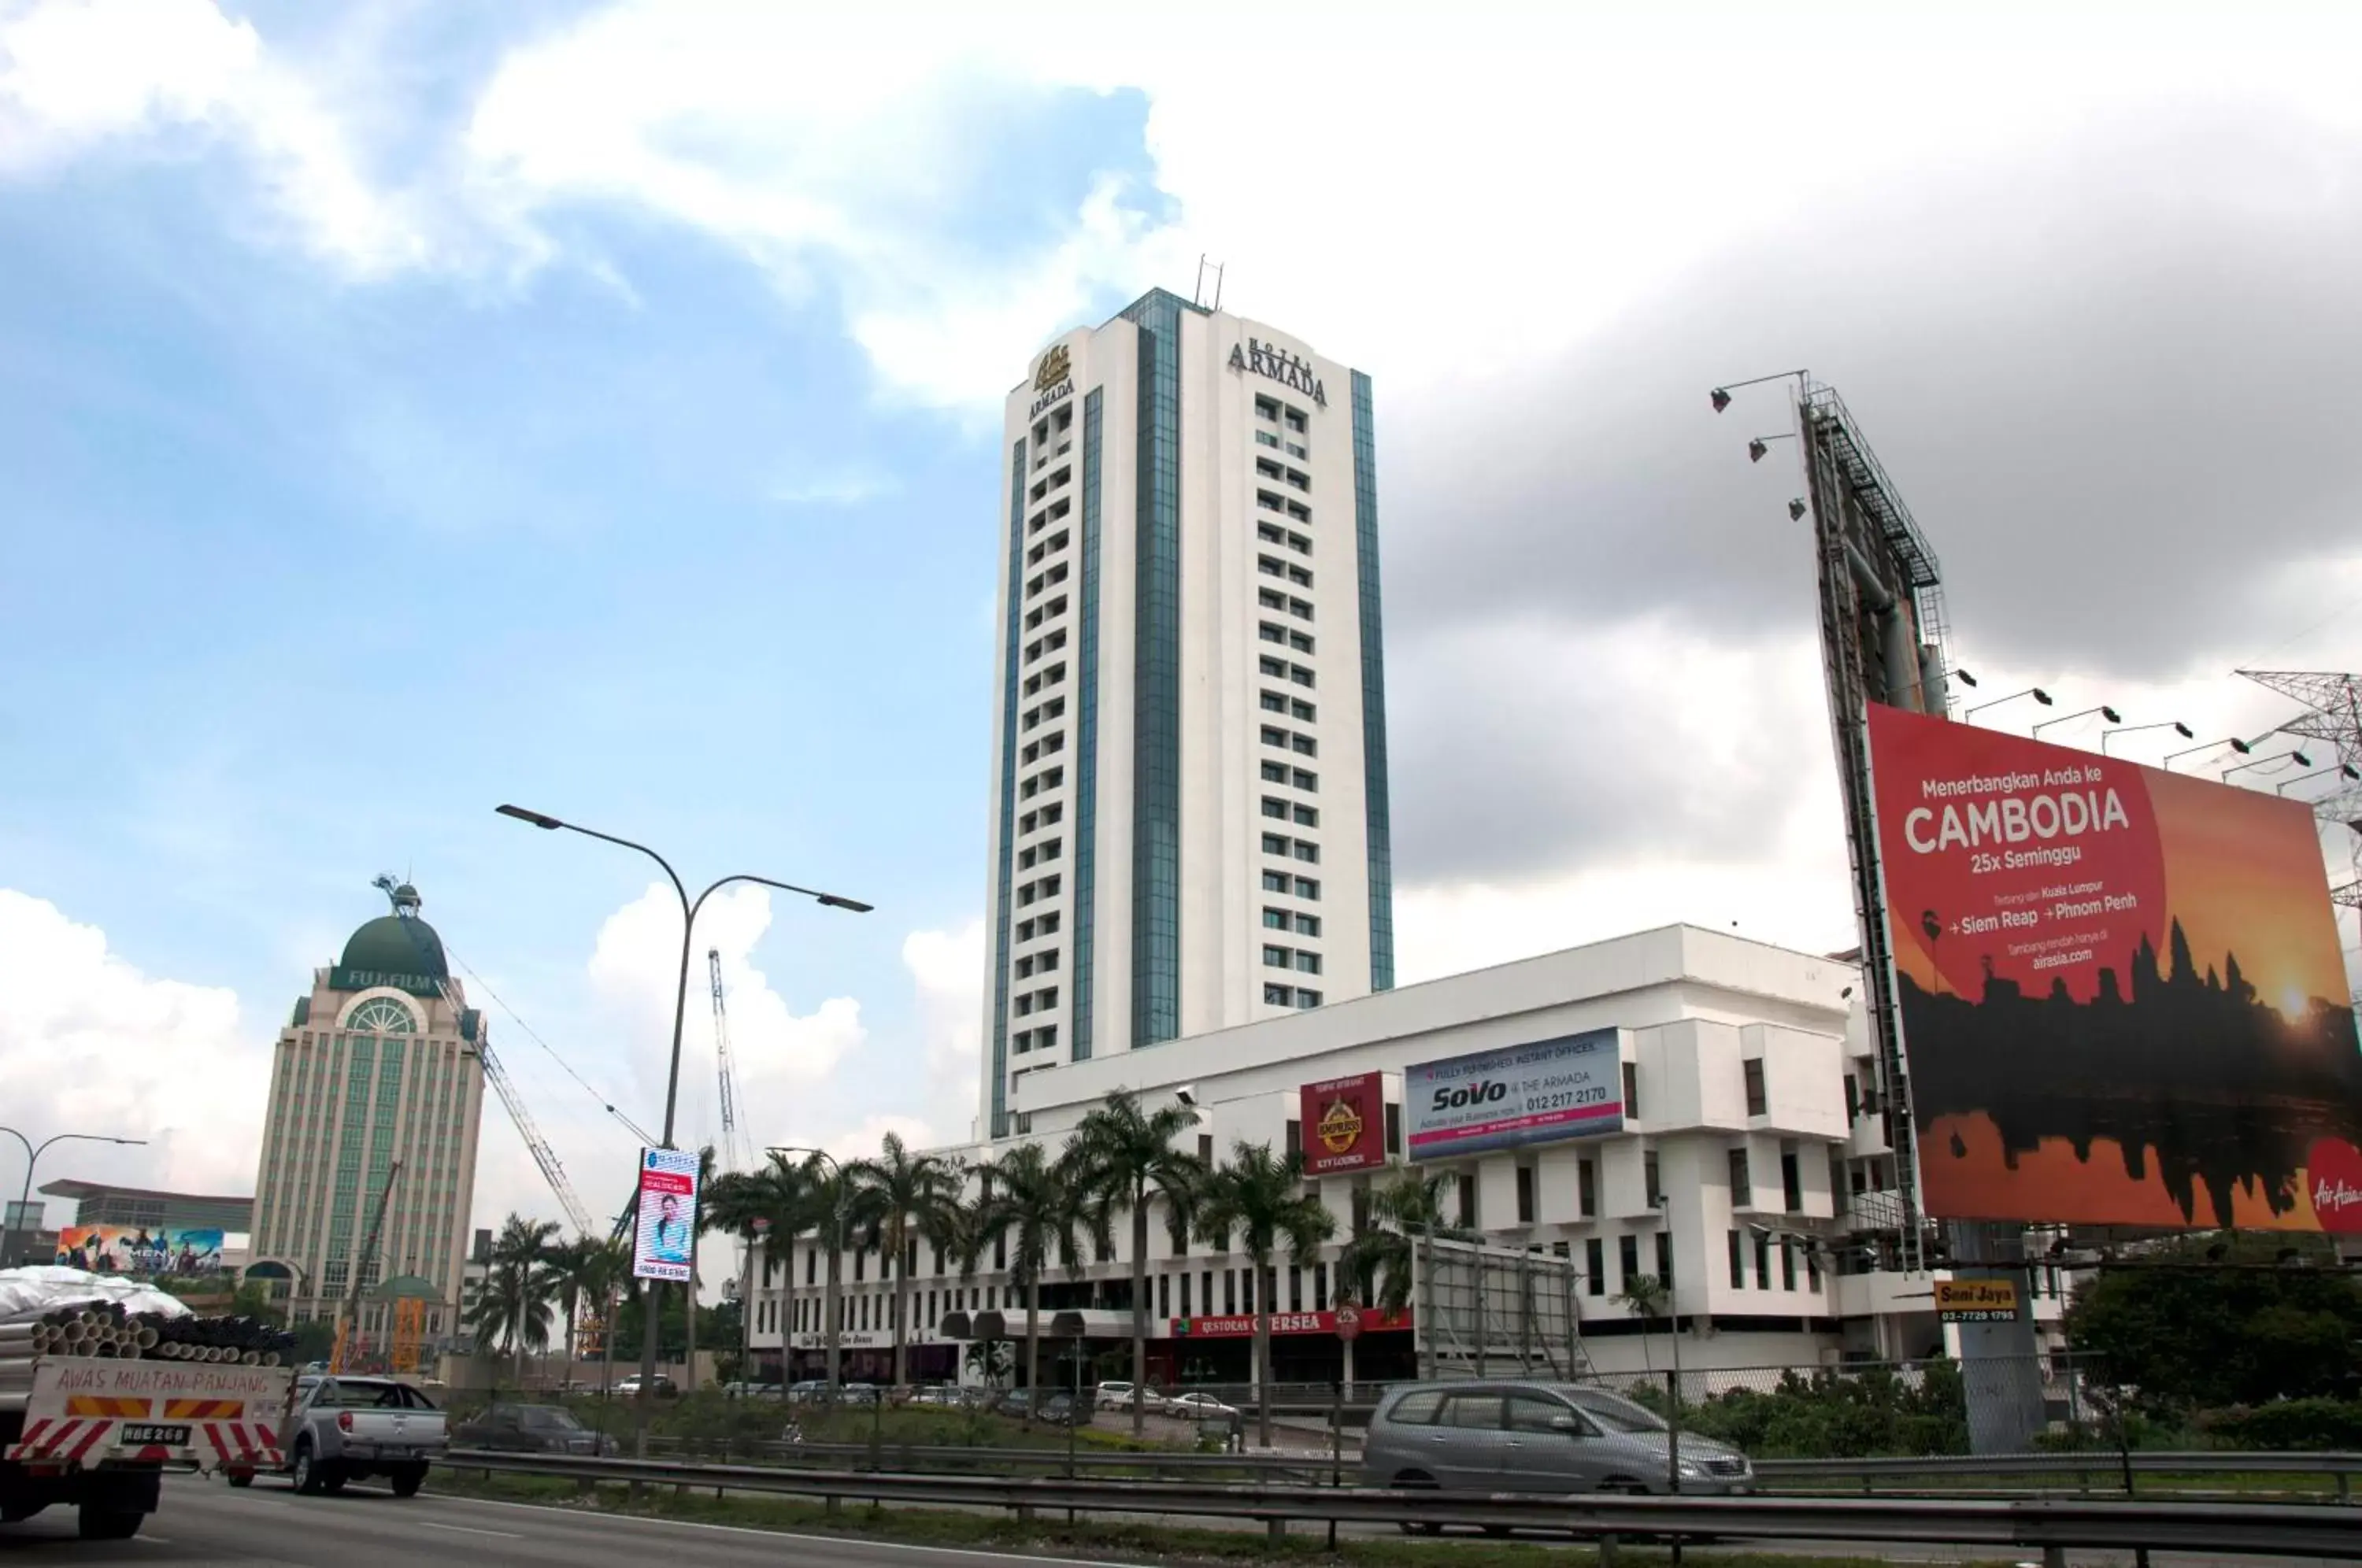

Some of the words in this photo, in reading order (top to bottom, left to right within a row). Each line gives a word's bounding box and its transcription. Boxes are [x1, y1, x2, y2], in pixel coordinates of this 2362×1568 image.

[1249, 337, 1312, 377] HOTEL
[1227, 342, 1327, 407] ARMADA
[1028, 378, 1075, 423] ARMADA
[1922, 771, 2039, 798] Menerbangkan
[2044, 767, 2082, 786] Anda
[2084, 765, 2102, 782] ke
[1905, 787, 2129, 853] CAMBODIA
[1971, 854, 2001, 874] 25x
[2005, 845, 2081, 870] Seminggu
[2042, 886, 2067, 899] Kuala
[2068, 881, 2104, 895] Lumpur
[1961, 915, 1999, 935] Siem
[2001, 910, 2038, 927] Reap
[2056, 900, 2103, 920] Phnom
[2105, 892, 2137, 912] Penh
[2034, 949, 2092, 970] airasia.com
[348, 970, 431, 989] FUJIFILM
[1431, 1079, 1506, 1112] SoVo
[1542, 1071, 1590, 1089] ARMADA
[1941, 1285, 1974, 1303] Seni
[1976, 1285, 2012, 1304] Jaya
[56, 1368, 109, 1391] AWAS
[114, 1370, 186, 1391] MUATAN
[191, 1372, 269, 1393] PANJANG
